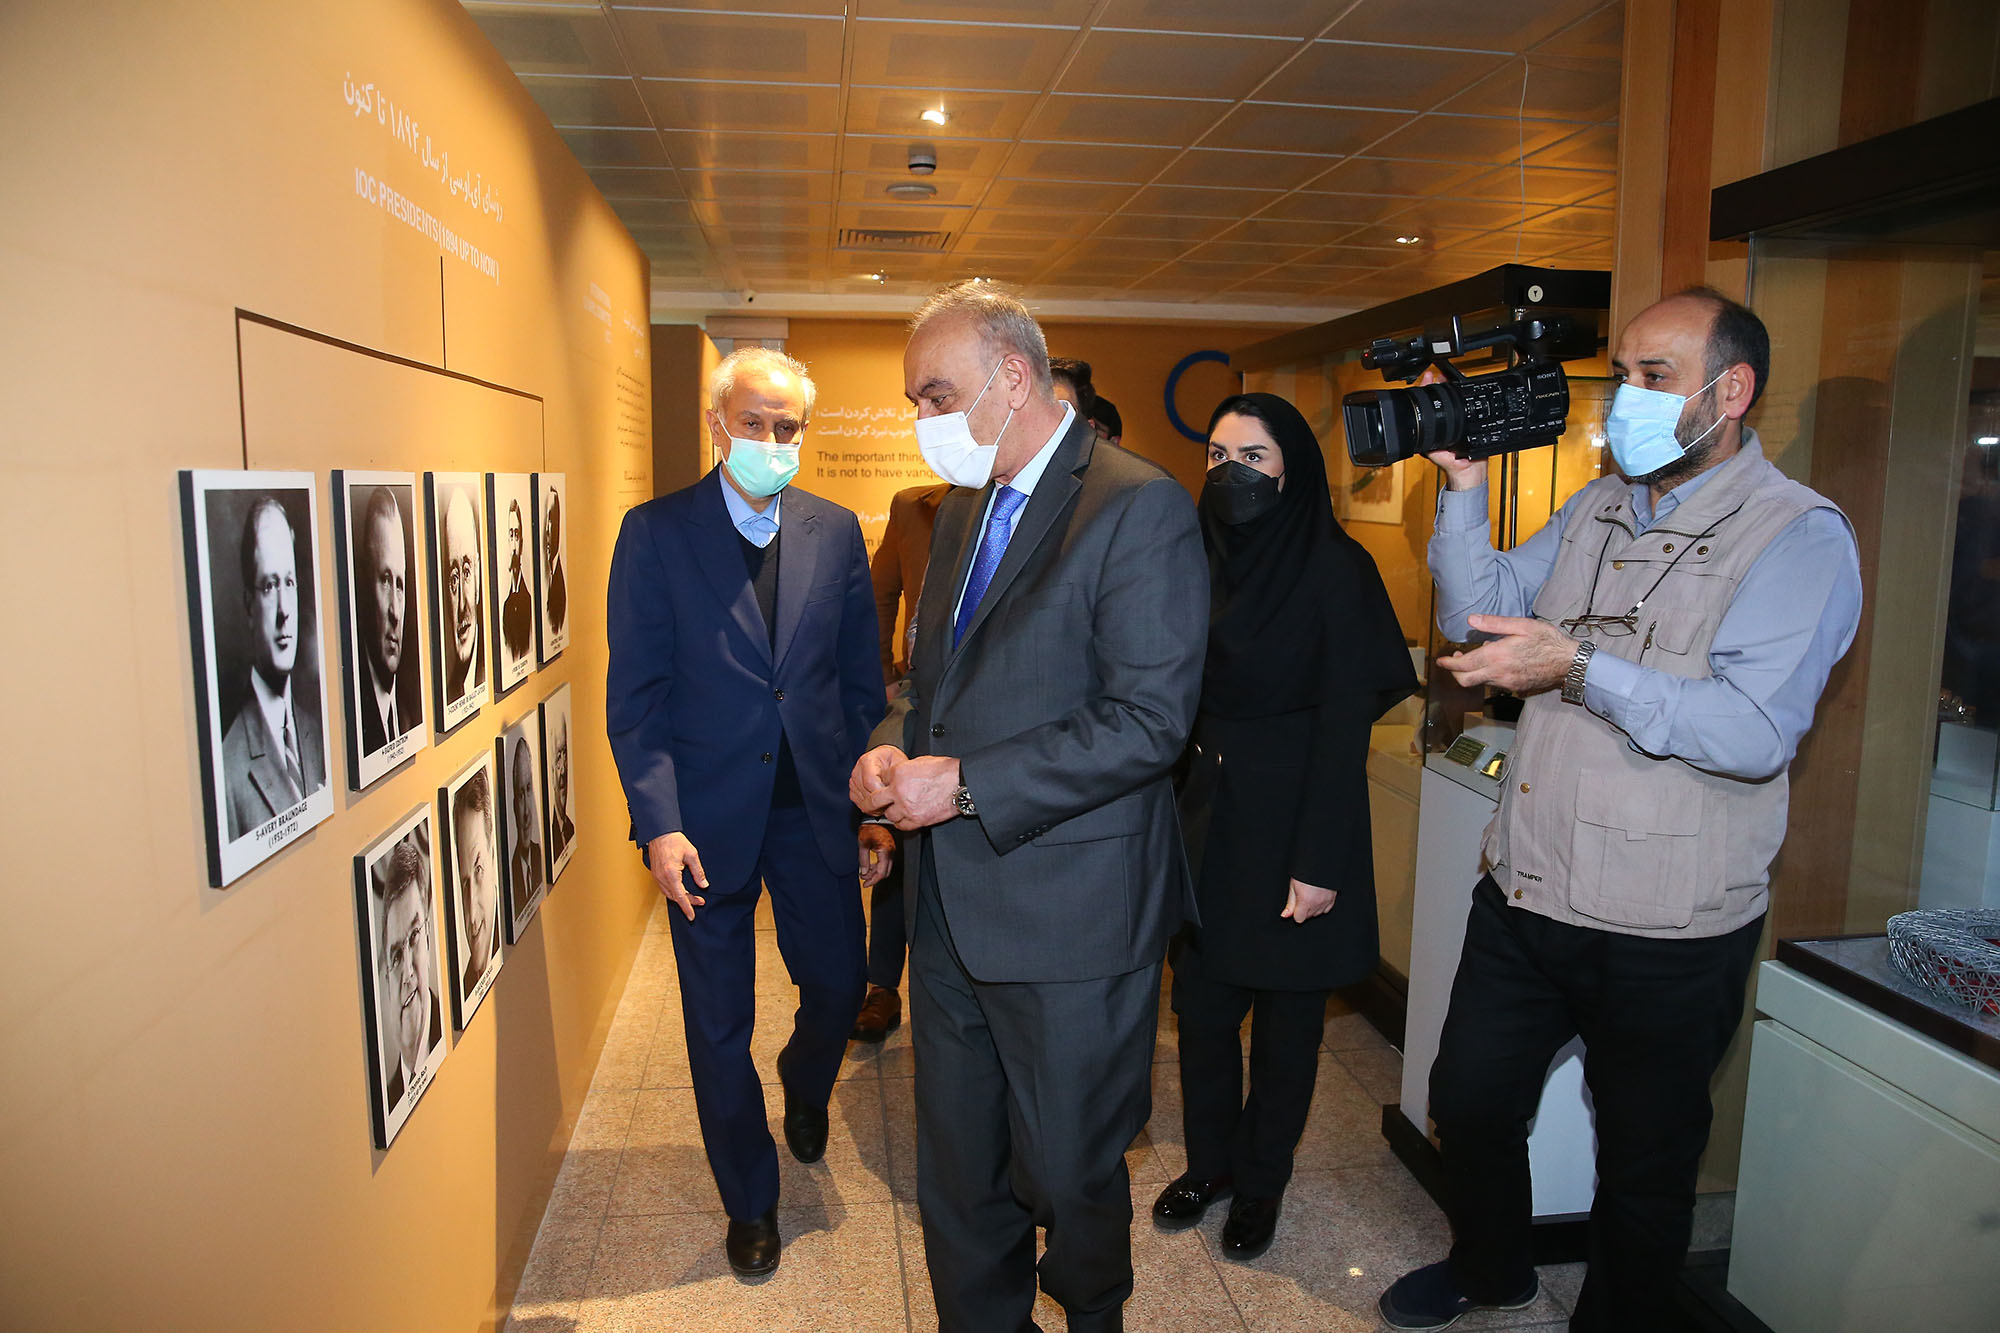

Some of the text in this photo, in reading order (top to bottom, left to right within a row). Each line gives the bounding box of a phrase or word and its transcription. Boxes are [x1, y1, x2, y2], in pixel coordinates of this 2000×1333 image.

[376, 89, 387, 126] تا
[390, 101, 420, 155] ۱۸۹۴
[421, 135, 439, 172] سال
[441, 151, 449, 184] از
[354, 167, 377, 204] IOC
[469, 244, 480, 269] TO
[1536, 371, 1557, 380] SONY
[844, 405, 871, 421] کردن
[843, 423, 871, 440] کردن
[817, 450, 839, 463] The
[841, 451, 895, 465] important
[816, 467, 824, 479] It
[827, 467, 837, 479] is
[840, 468, 858, 479] not
[861, 468, 872, 479] to
[875, 467, 903, 479] have
[268, 820, 299, 849] (1952-1972)
[1516, 869, 1543, 883] TRAMPER
